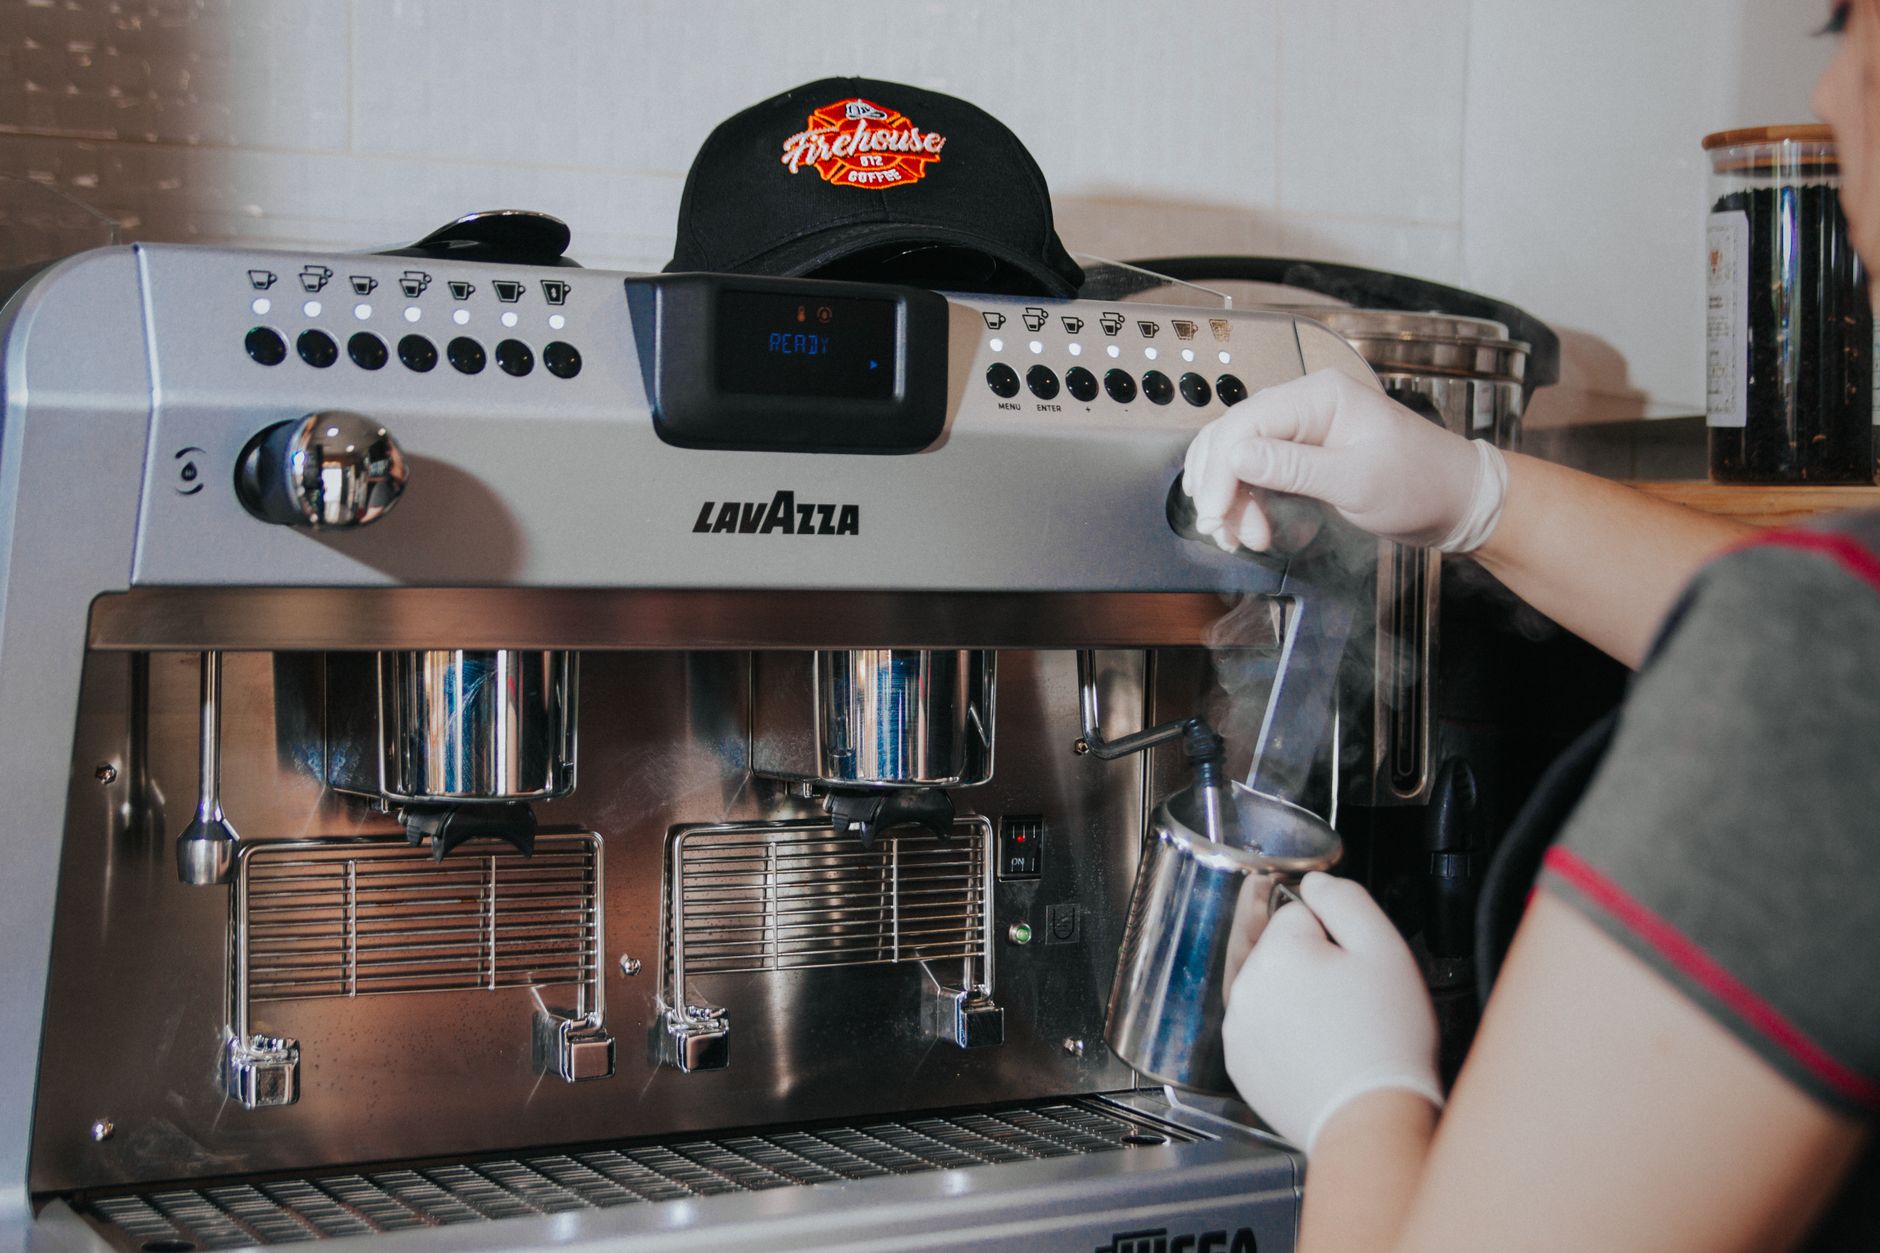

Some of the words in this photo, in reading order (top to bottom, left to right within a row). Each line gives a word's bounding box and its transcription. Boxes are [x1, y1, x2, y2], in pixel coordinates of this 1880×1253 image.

[781, 118, 946, 175] Firehouse
[848, 168, 902, 184] COFFEE
[769, 332, 830, 355] READY
[998, 402, 1022, 412] MENU
[1036, 403, 1063, 413] ENTER
[692, 490, 860, 535] LAVAZZA
[1010, 857, 1025, 866] ON
